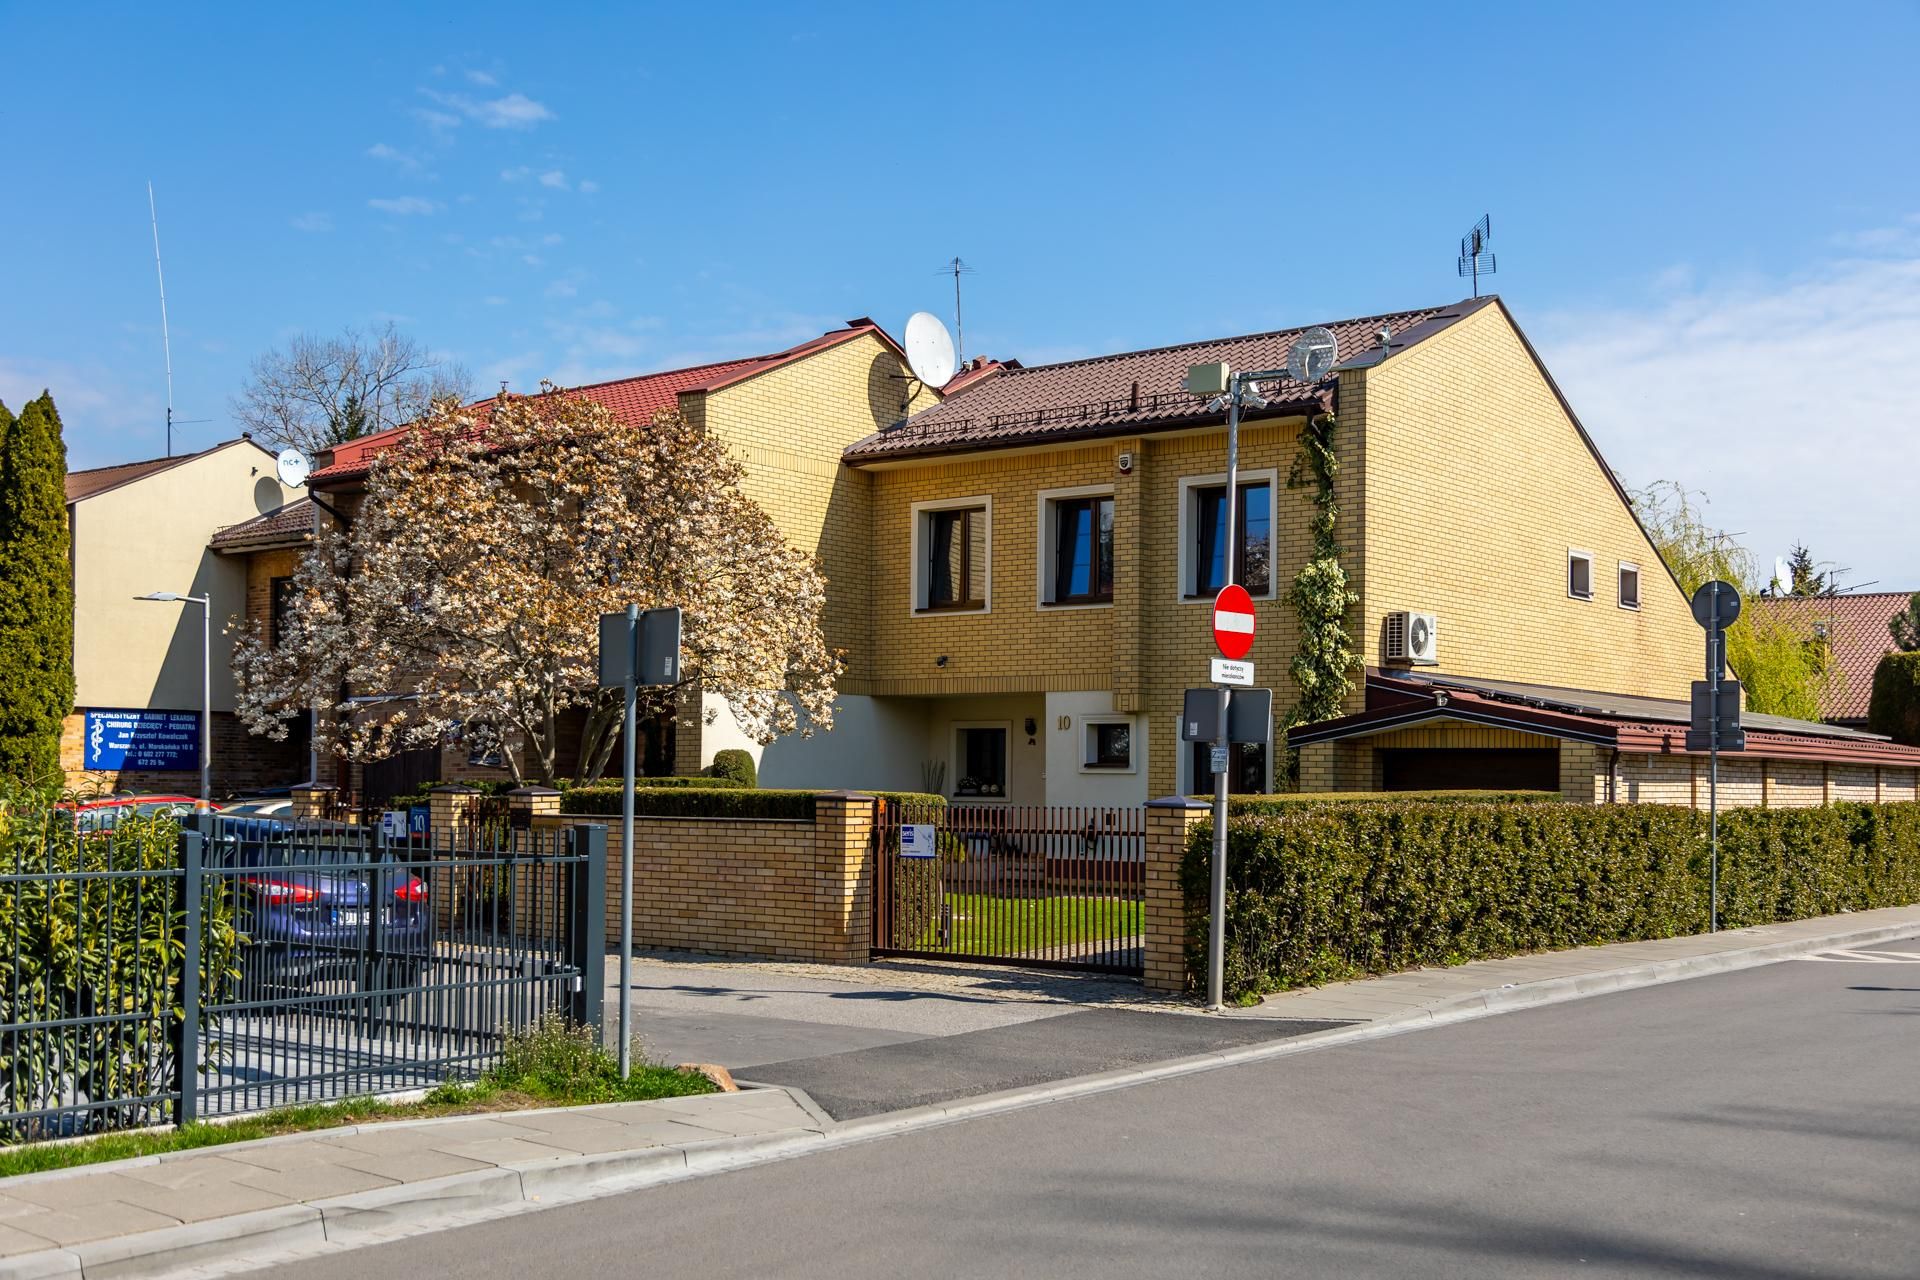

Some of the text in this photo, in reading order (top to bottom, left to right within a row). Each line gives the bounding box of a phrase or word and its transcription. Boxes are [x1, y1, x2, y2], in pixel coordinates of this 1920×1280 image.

[90, 712, 140, 720] SPECJALISTYCZNY
[1057, 714, 1071, 731] 10
[118, 731, 130, 739] Jan
[130, 732, 157, 740] Krzysztof
[413, 814, 426, 831] 10
